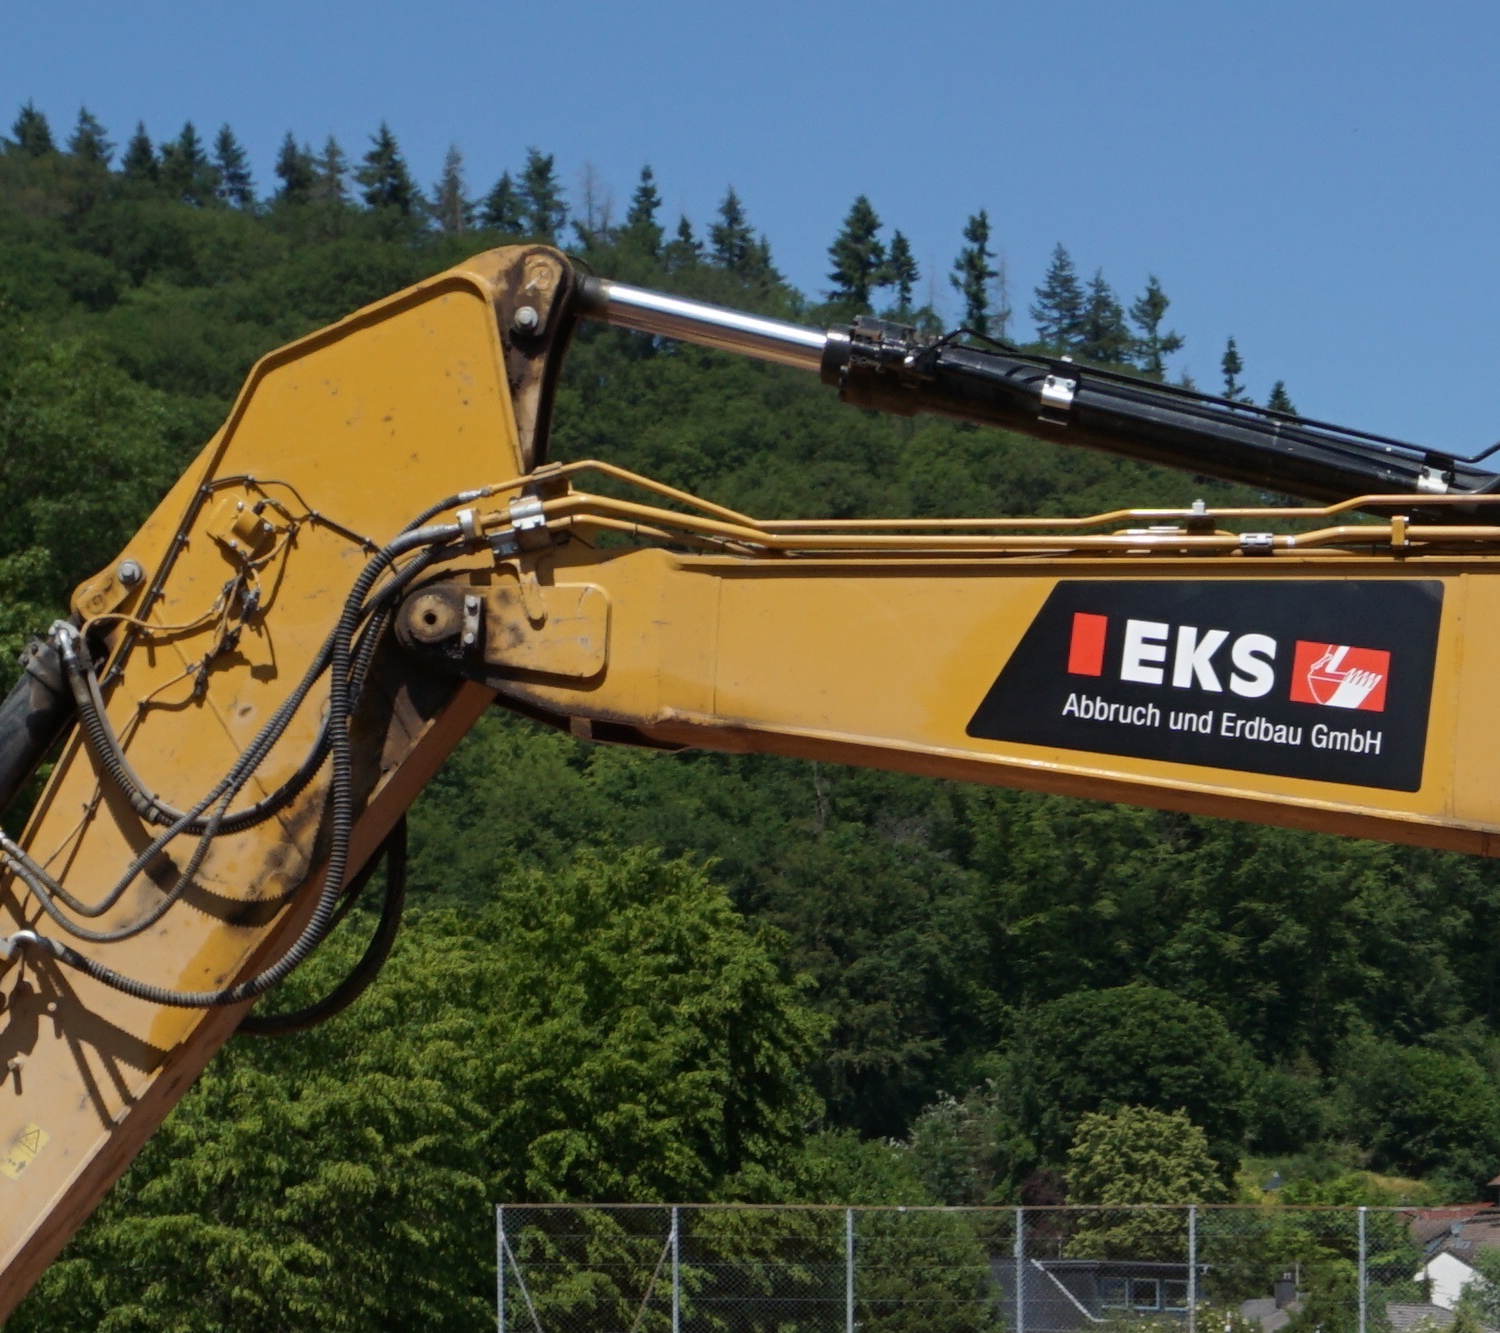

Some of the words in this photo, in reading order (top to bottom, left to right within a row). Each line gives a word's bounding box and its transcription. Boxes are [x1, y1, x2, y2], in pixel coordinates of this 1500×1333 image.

[1119, 617, 1278, 698] EKS
[1061, 692, 1161, 728] Abbruch
[1168, 704, 1212, 735] und
[1220, 711, 1302, 746] Erdbau
[1310, 724, 1383, 755] GmbH
